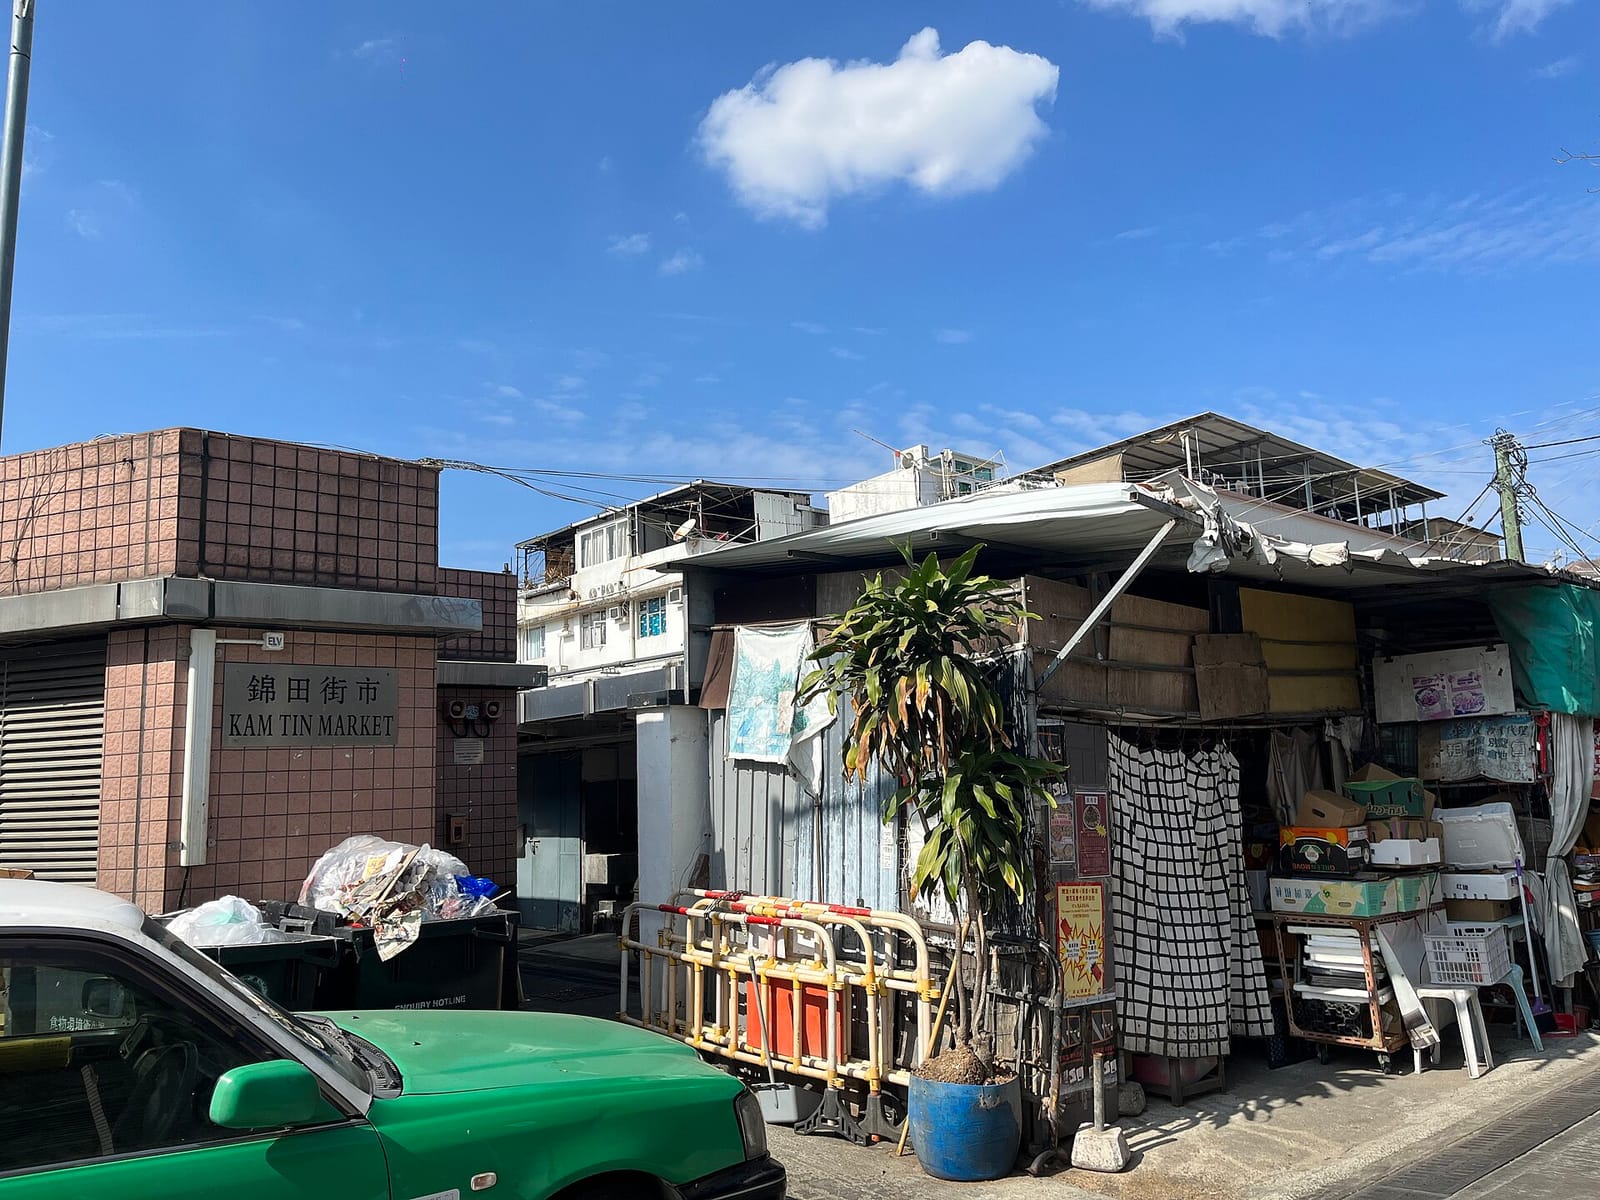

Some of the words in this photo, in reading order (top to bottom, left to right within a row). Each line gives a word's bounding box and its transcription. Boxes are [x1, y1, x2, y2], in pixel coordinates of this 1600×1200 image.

[267, 636, 283, 646] ELV
[247, 674, 380, 704] 錦田街市
[229, 714, 273, 737] KAM
[279, 714, 312, 737] TIN
[318, 714, 394, 737] MARKET
[432, 995, 466, 1008] HOTLINE
